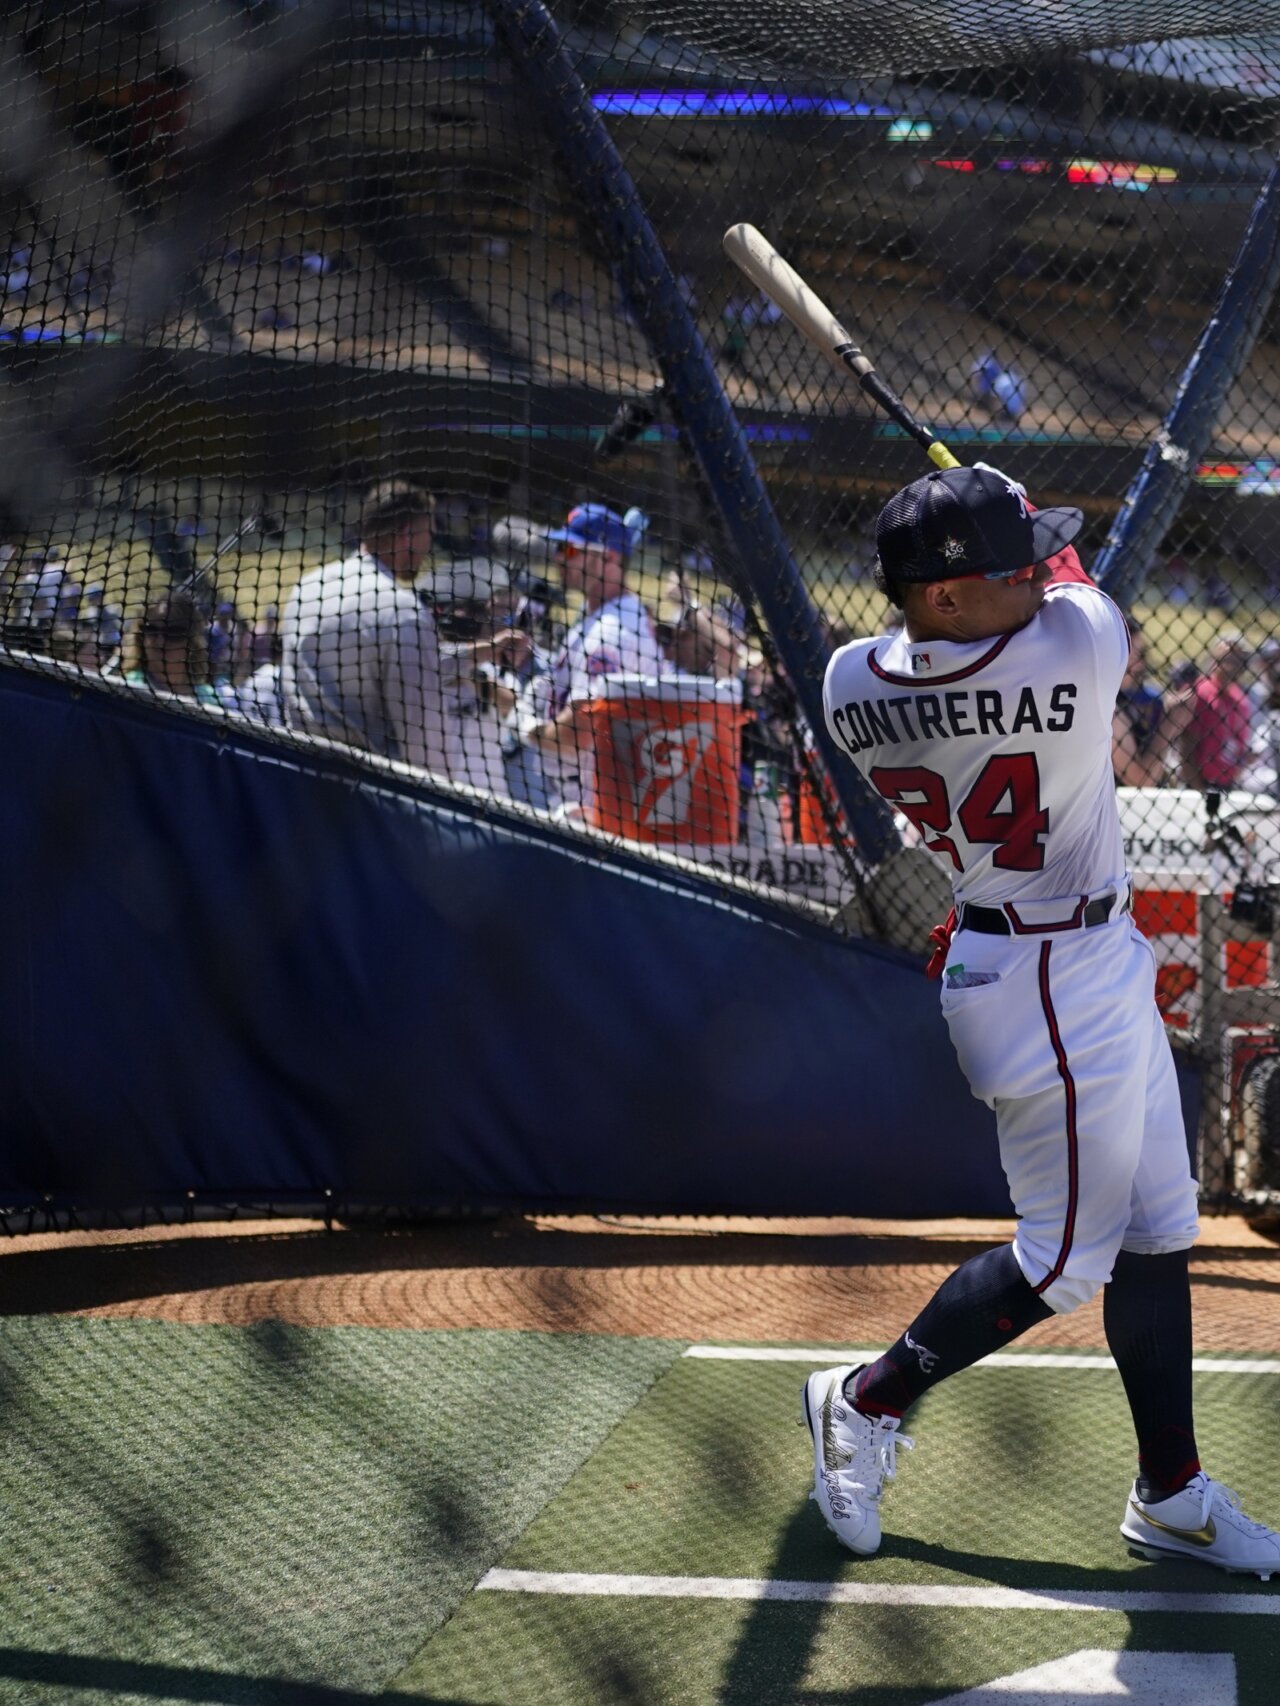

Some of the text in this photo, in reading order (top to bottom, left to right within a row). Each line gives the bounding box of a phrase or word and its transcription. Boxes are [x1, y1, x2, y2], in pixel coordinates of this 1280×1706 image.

[945, 544, 964, 557] ASG
[832, 683, 1078, 755] CONTRERAS
[868, 751, 1051, 875] 24
[820, 1430, 852, 1520] Angeles
